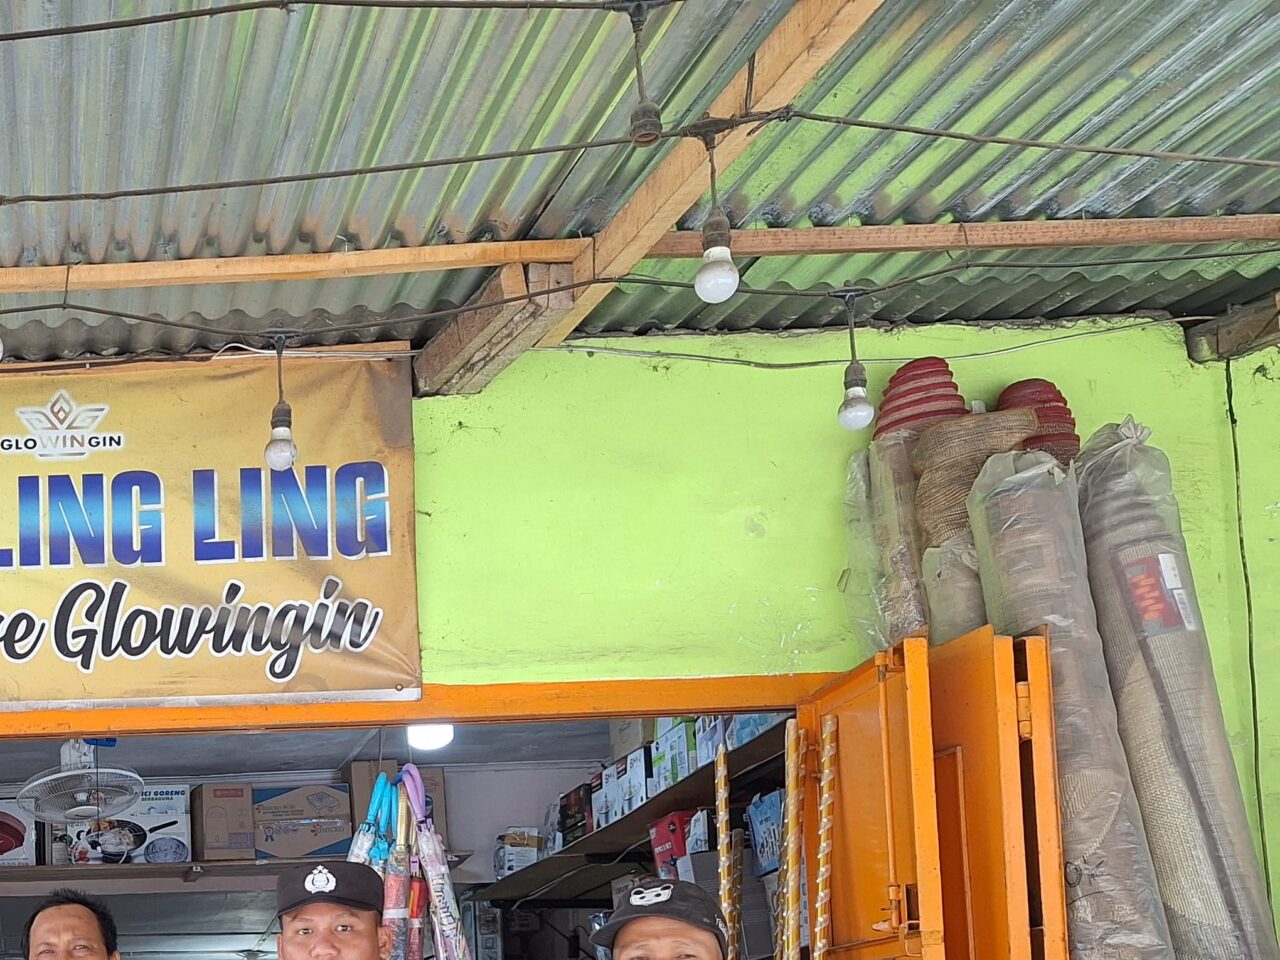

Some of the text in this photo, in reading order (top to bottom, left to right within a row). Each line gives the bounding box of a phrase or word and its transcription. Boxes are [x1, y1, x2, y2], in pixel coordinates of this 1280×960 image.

[0, 434, 122, 451] GLOWINGIN
[192, 461, 389, 562] LING
[53, 577, 381, 680] Glowingin
